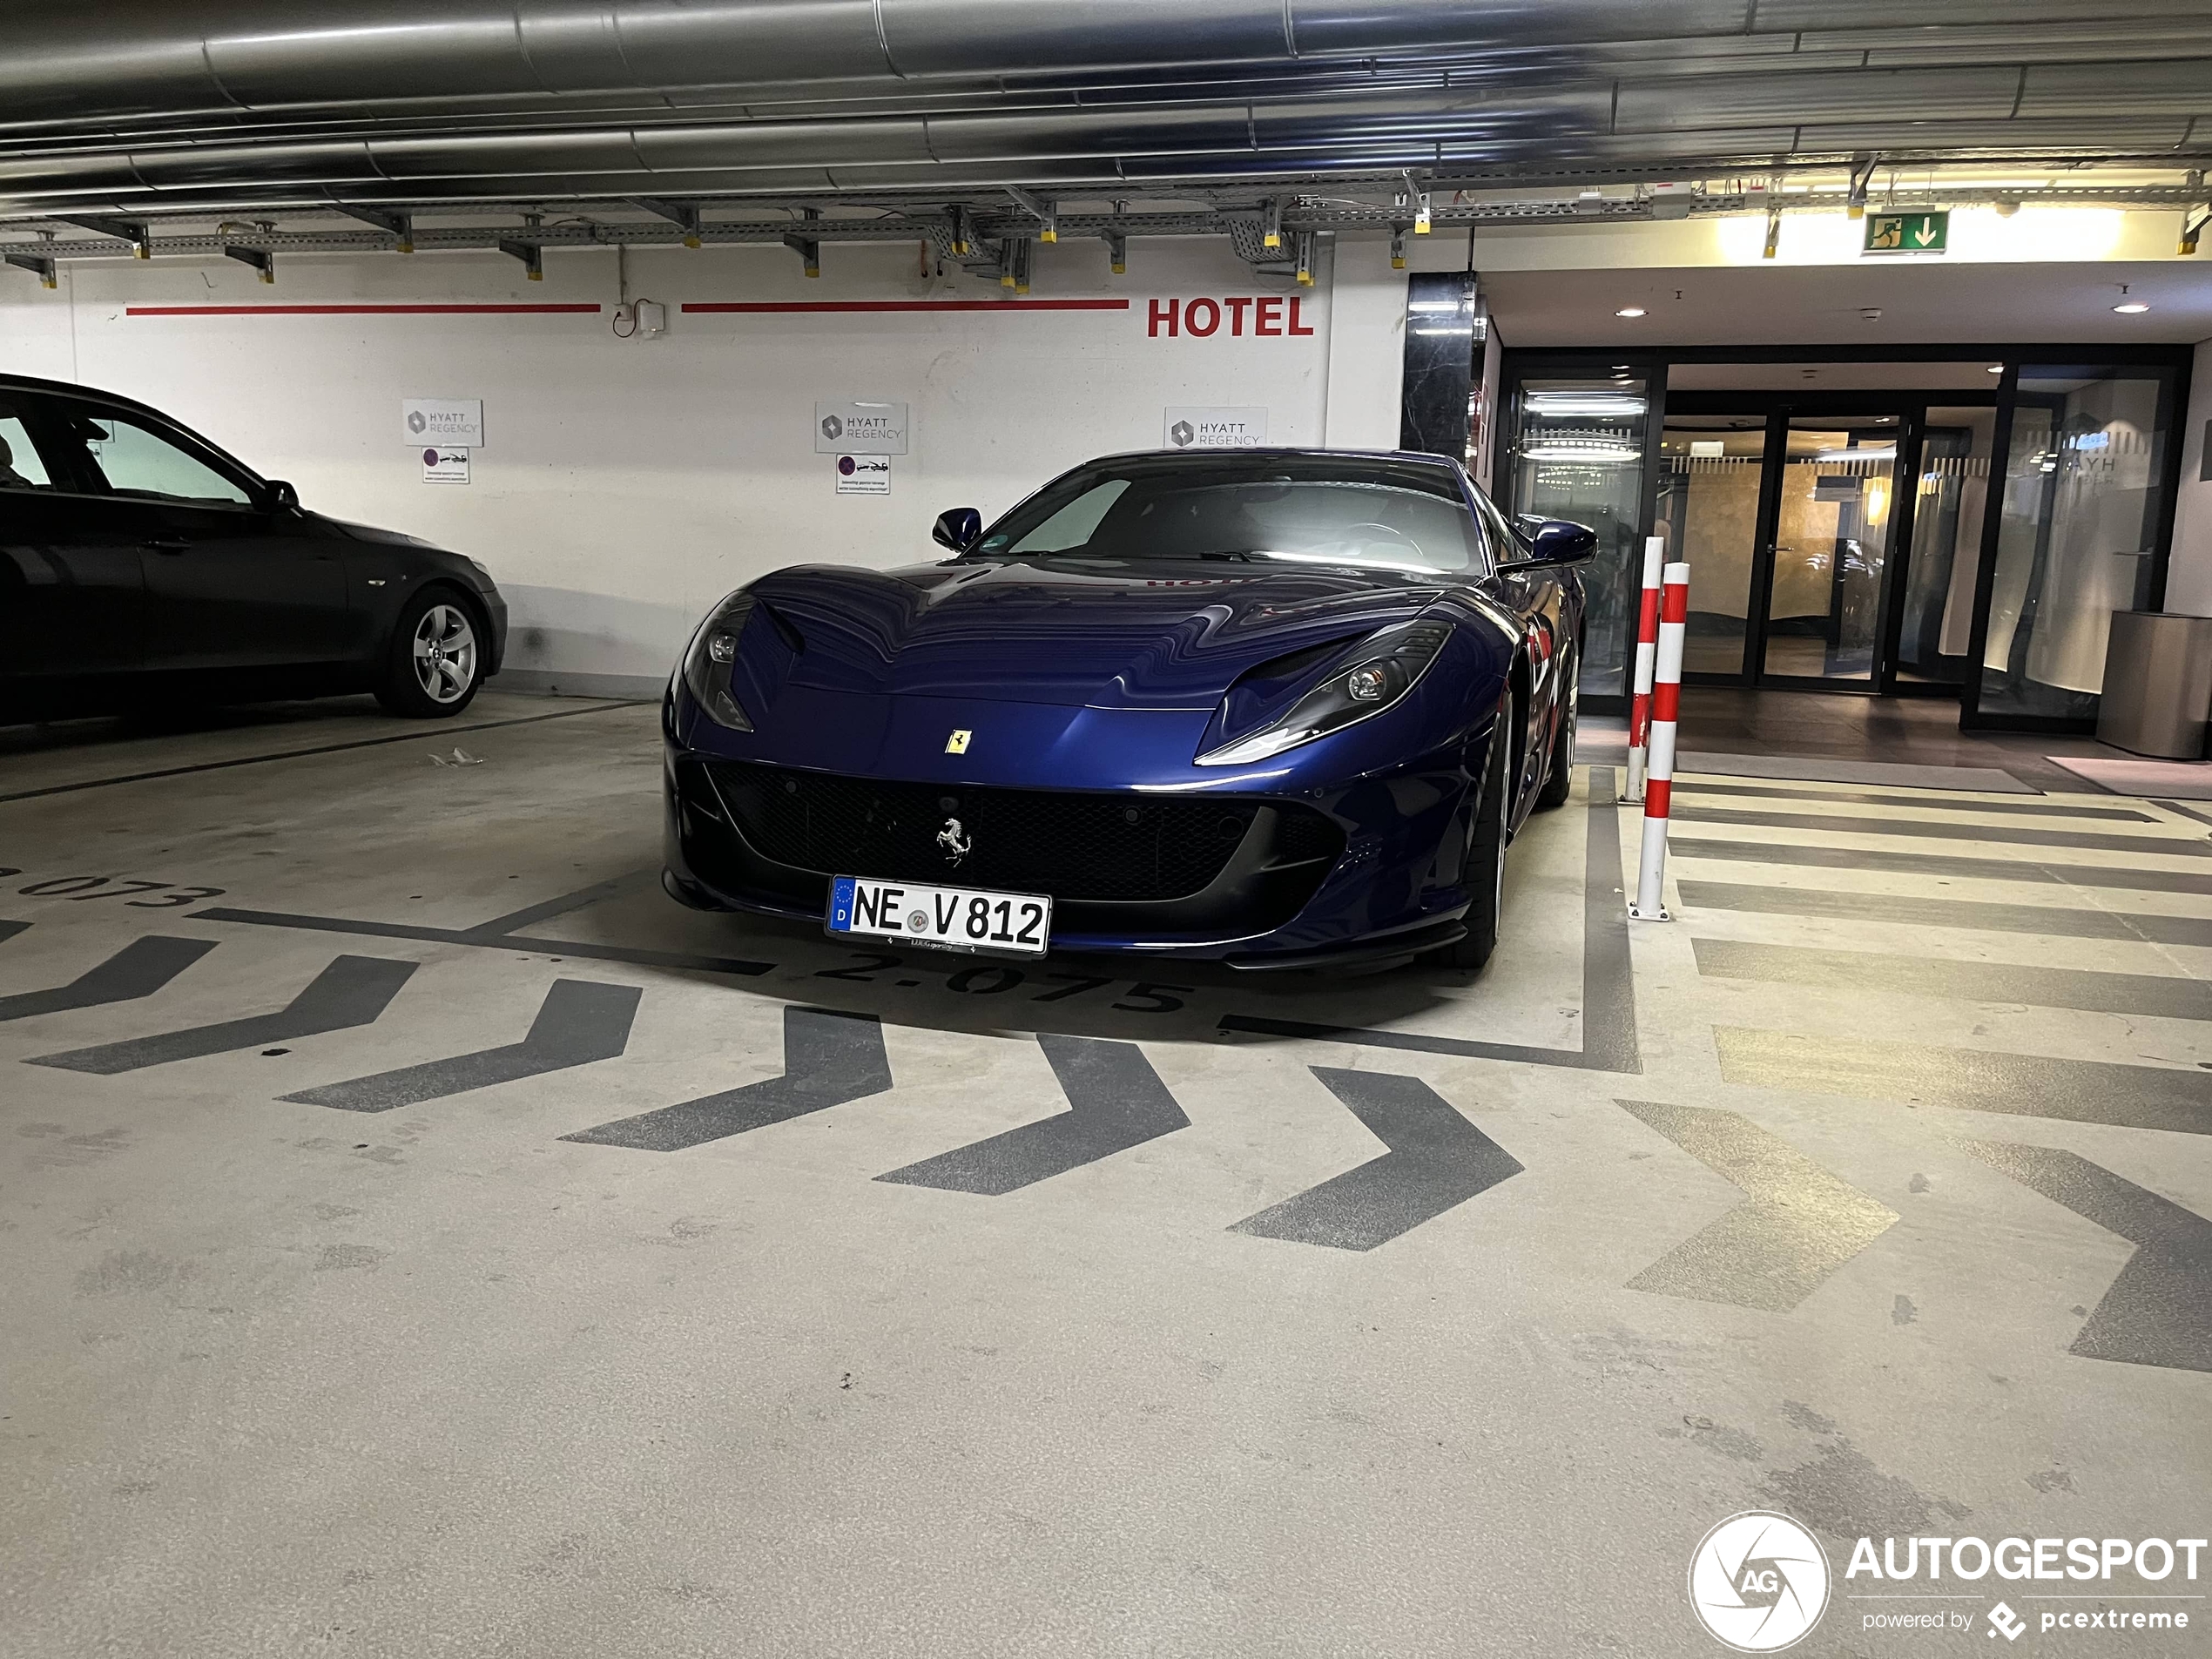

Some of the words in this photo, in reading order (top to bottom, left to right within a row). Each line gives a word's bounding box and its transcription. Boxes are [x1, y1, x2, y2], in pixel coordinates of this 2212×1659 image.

[1148, 296, 1313, 338] HOTEL
[429, 413, 465, 422] HYATT
[847, 417, 888, 428] HYATT
[429, 423, 477, 433] REGENCY
[846, 428, 902, 439] REGENCY
[1200, 423, 1245, 433] HYATT
[1199, 435, 1260, 446] REGENCY
[0, 867, 226, 907] 073
[837, 909, 846, 921] D
[853, 886, 905, 930] NE
[934, 893, 959, 934] V
[966, 897, 1043, 945] 812
[813, 953, 1196, 1014] 2.075
